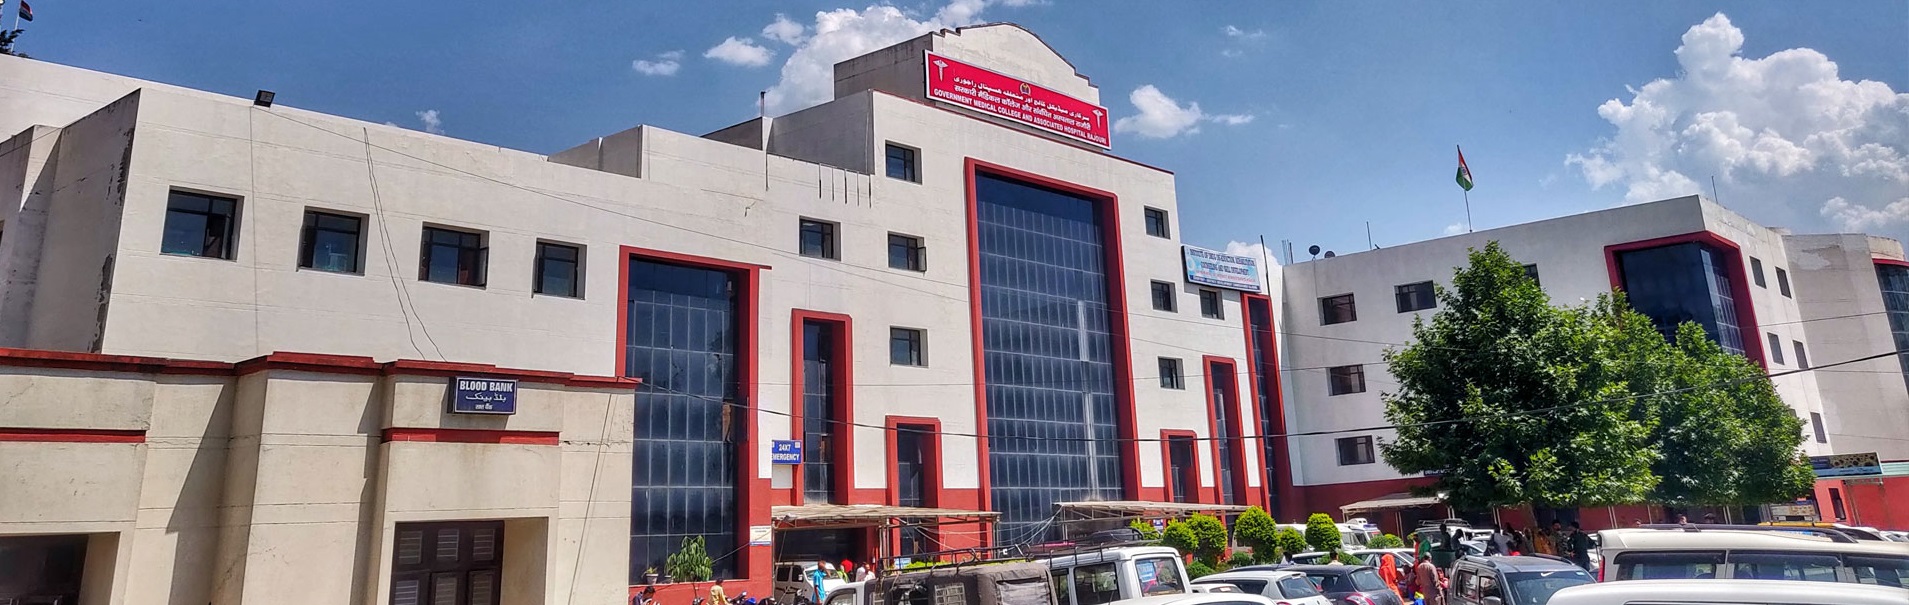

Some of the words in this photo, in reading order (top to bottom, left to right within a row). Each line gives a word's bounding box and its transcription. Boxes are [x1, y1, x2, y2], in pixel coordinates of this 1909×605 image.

[933, 88, 972, 105] GOVERNMENT
[973, 99, 998, 112] MEDICAL
[997, 106, 1021, 119] COLLEGE
[1022, 113, 1033, 122] AND
[1033, 116, 1063, 131] ASSOCIATED
[1063, 125, 1086, 138] HOSPITAL
[1086, 133, 1107, 144] RAJOURI
[460, 381, 487, 391] BLOOD
[489, 382, 513, 392] BANK
[493, 392, 506, 402] بلڈ
